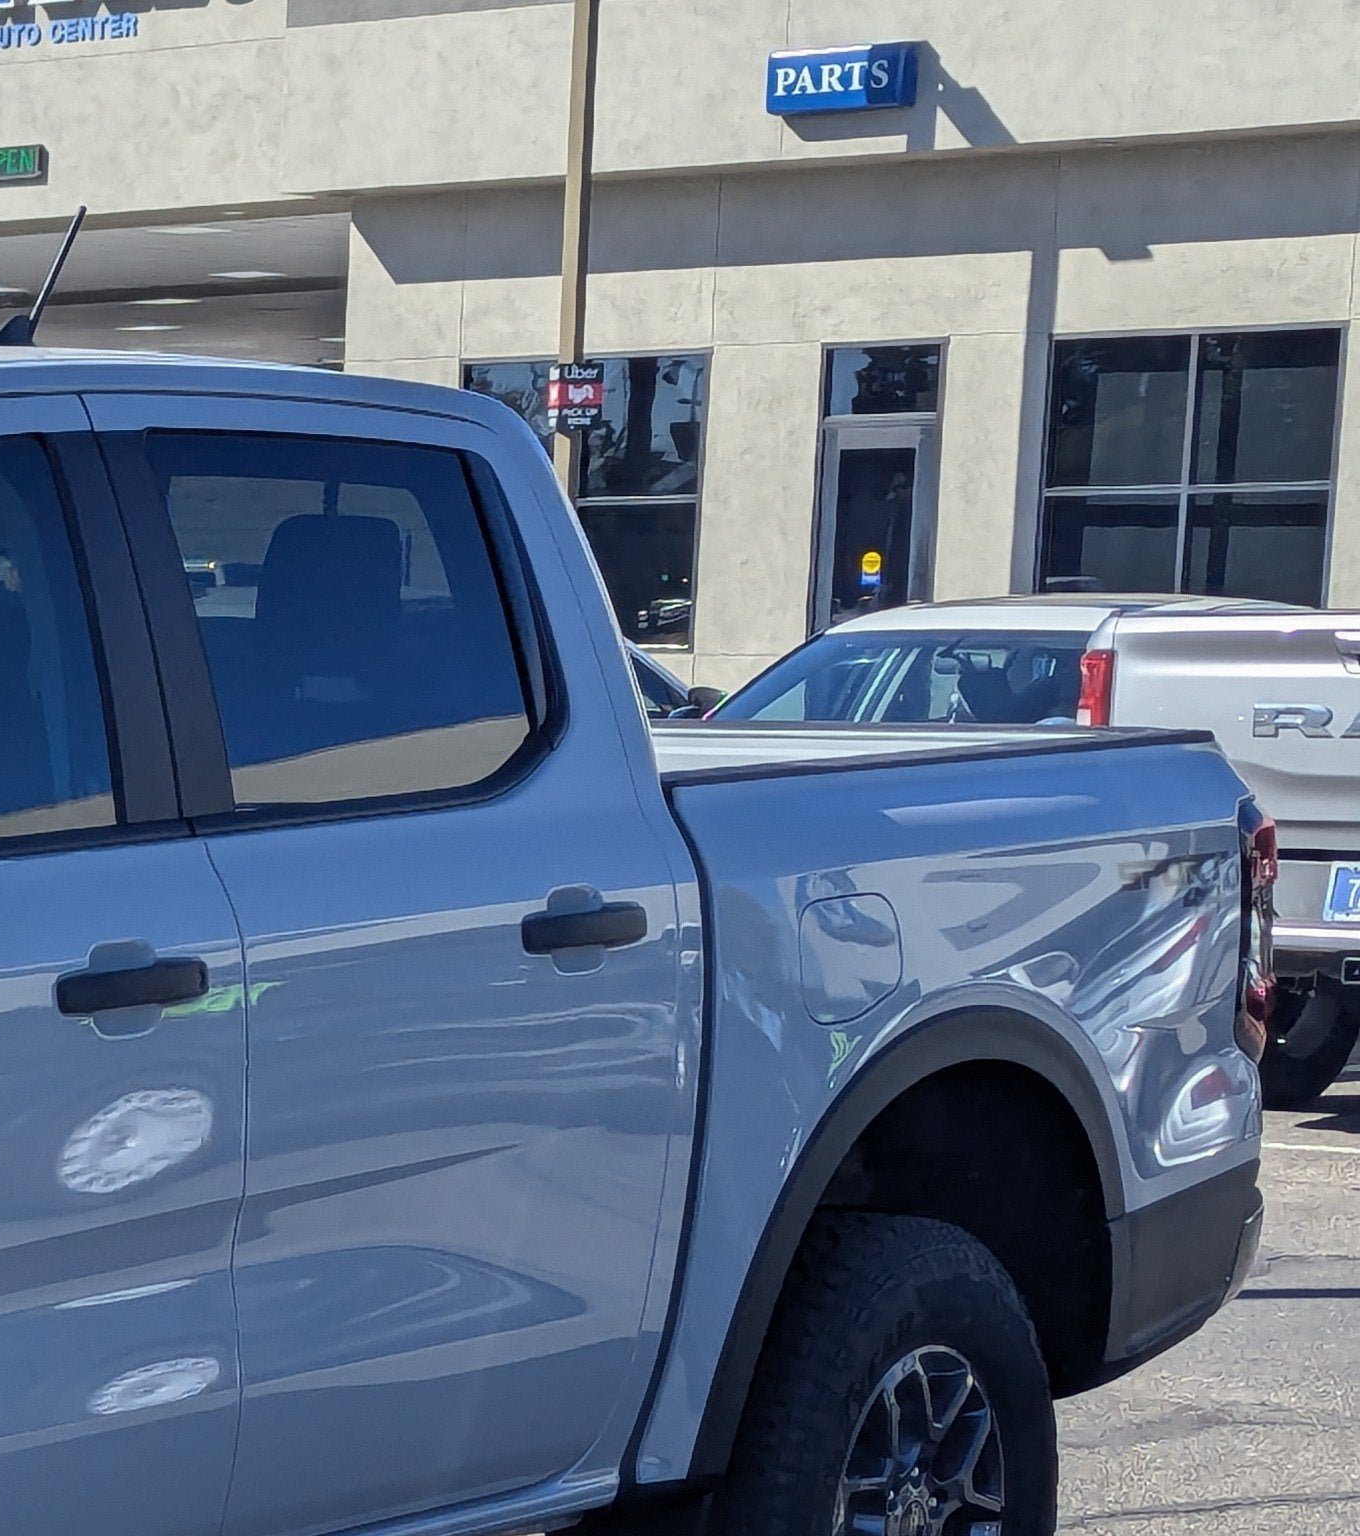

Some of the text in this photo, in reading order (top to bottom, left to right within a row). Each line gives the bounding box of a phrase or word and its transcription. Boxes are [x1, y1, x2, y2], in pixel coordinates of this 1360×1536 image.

[51, 13, 138, 44] CENTER
[773, 59, 890, 97] PARTS
[564, 364, 598, 379] Uber
